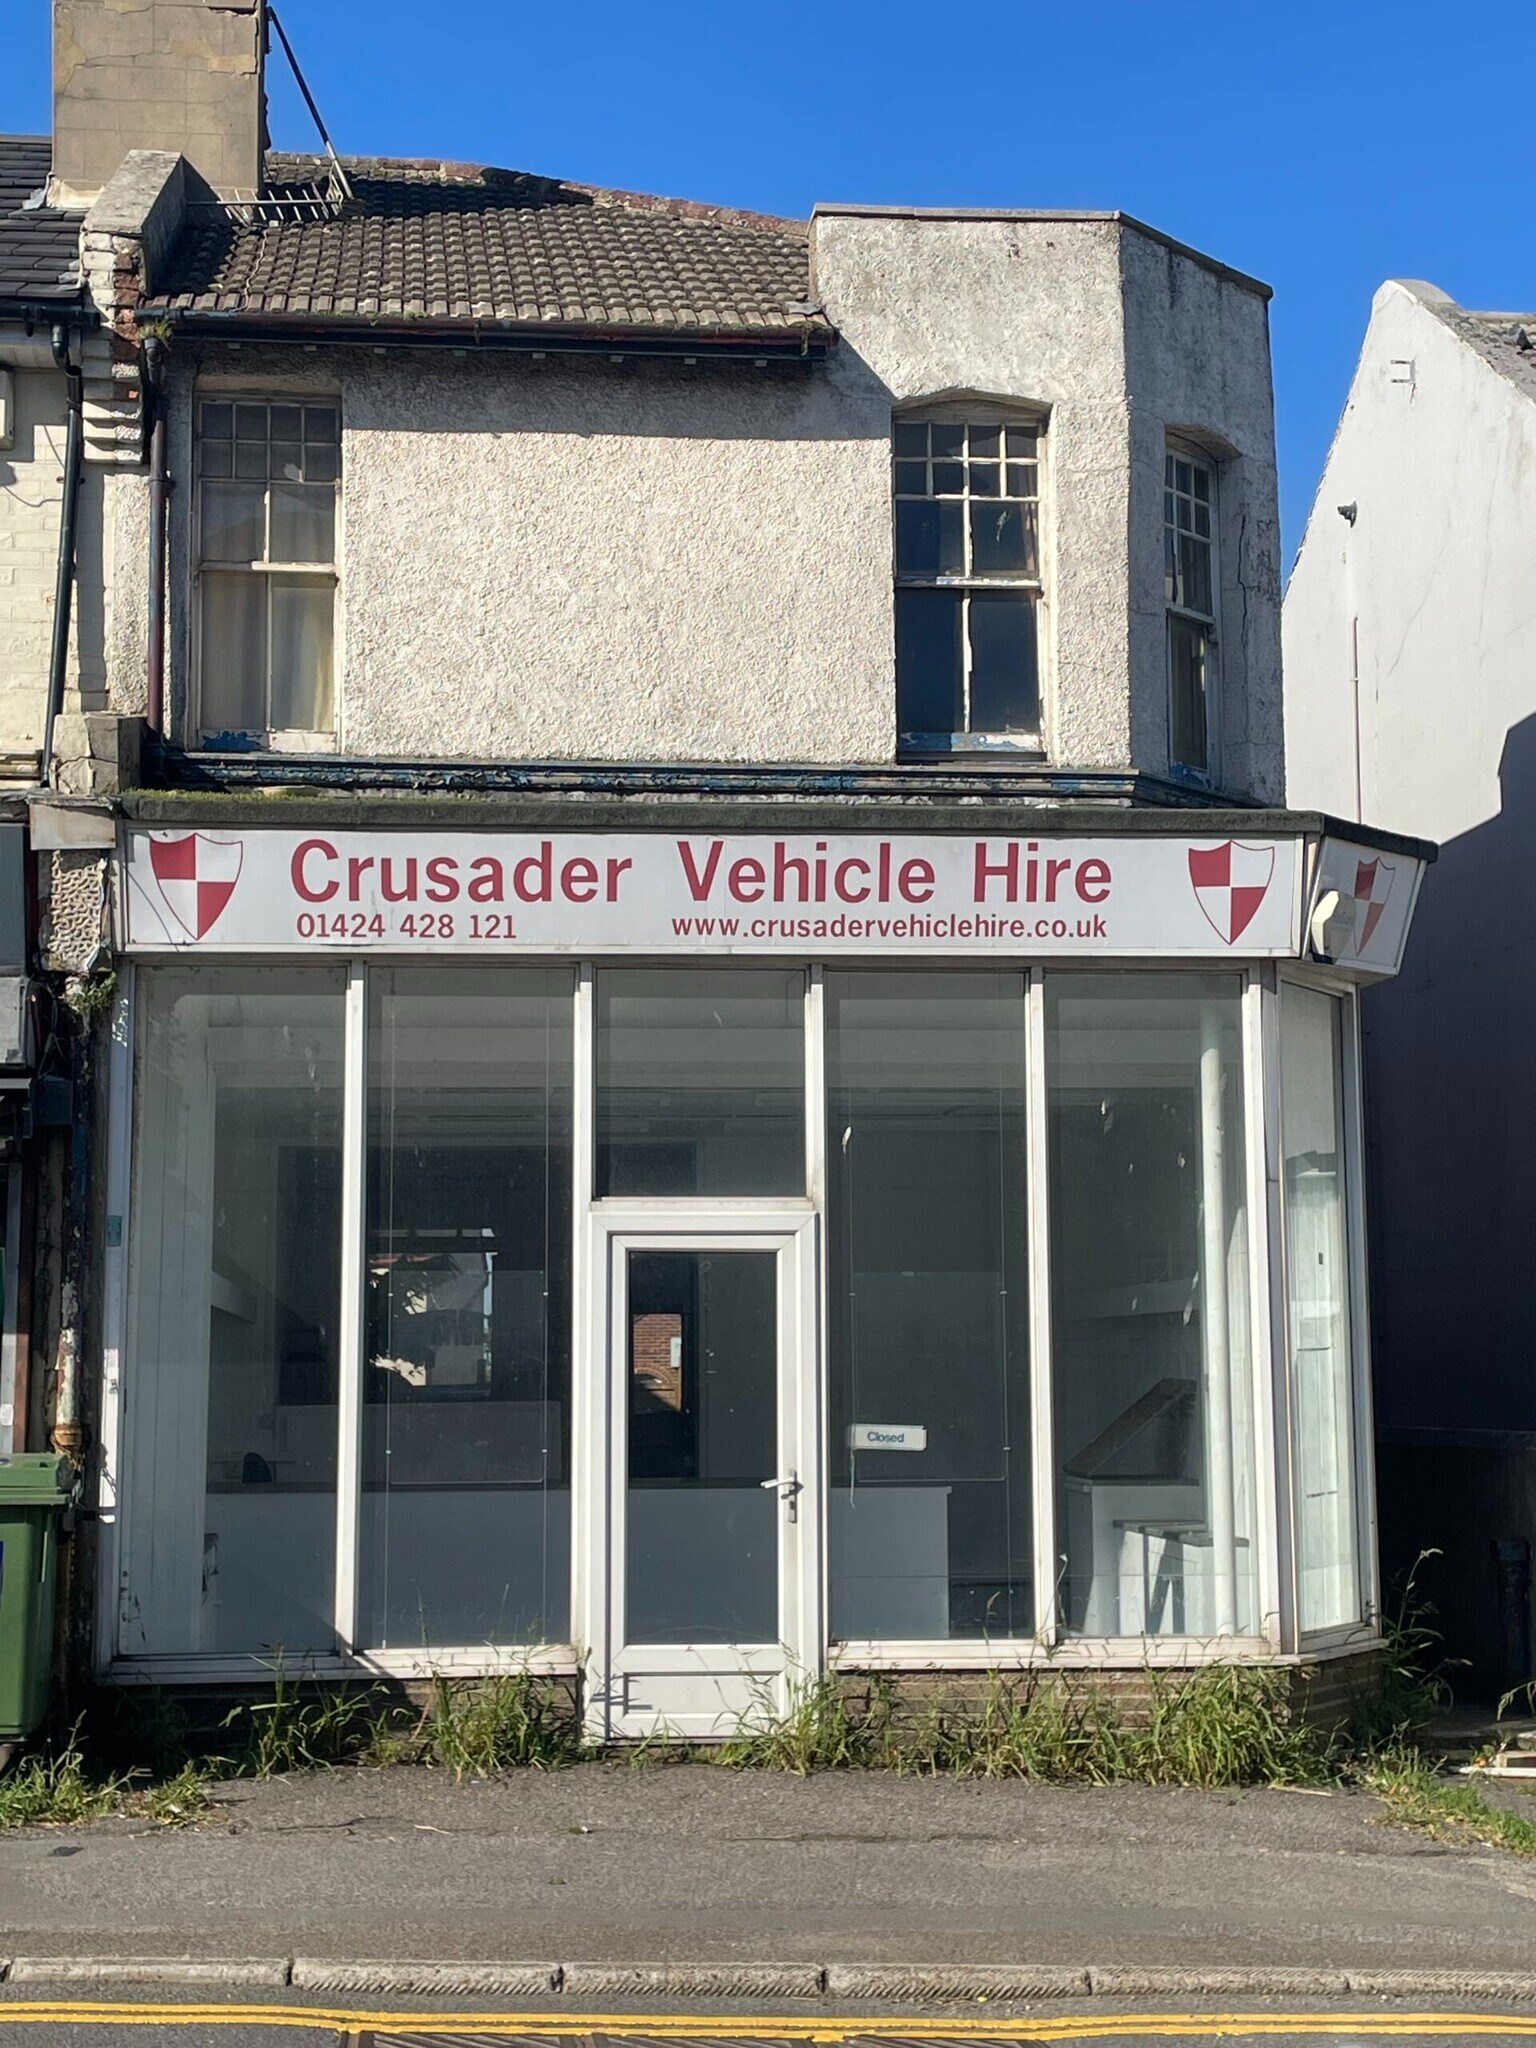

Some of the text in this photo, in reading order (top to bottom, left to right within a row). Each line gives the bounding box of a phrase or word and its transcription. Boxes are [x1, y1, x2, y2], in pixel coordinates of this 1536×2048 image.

[291, 838, 1112, 903] Crusader Vehicle Hire
[296, 913, 517, 939] 01424 428 121
[671, 913, 1108, 938] www.crusadervehiclehire.co.uk
[867, 1431, 905, 1443] Closed
